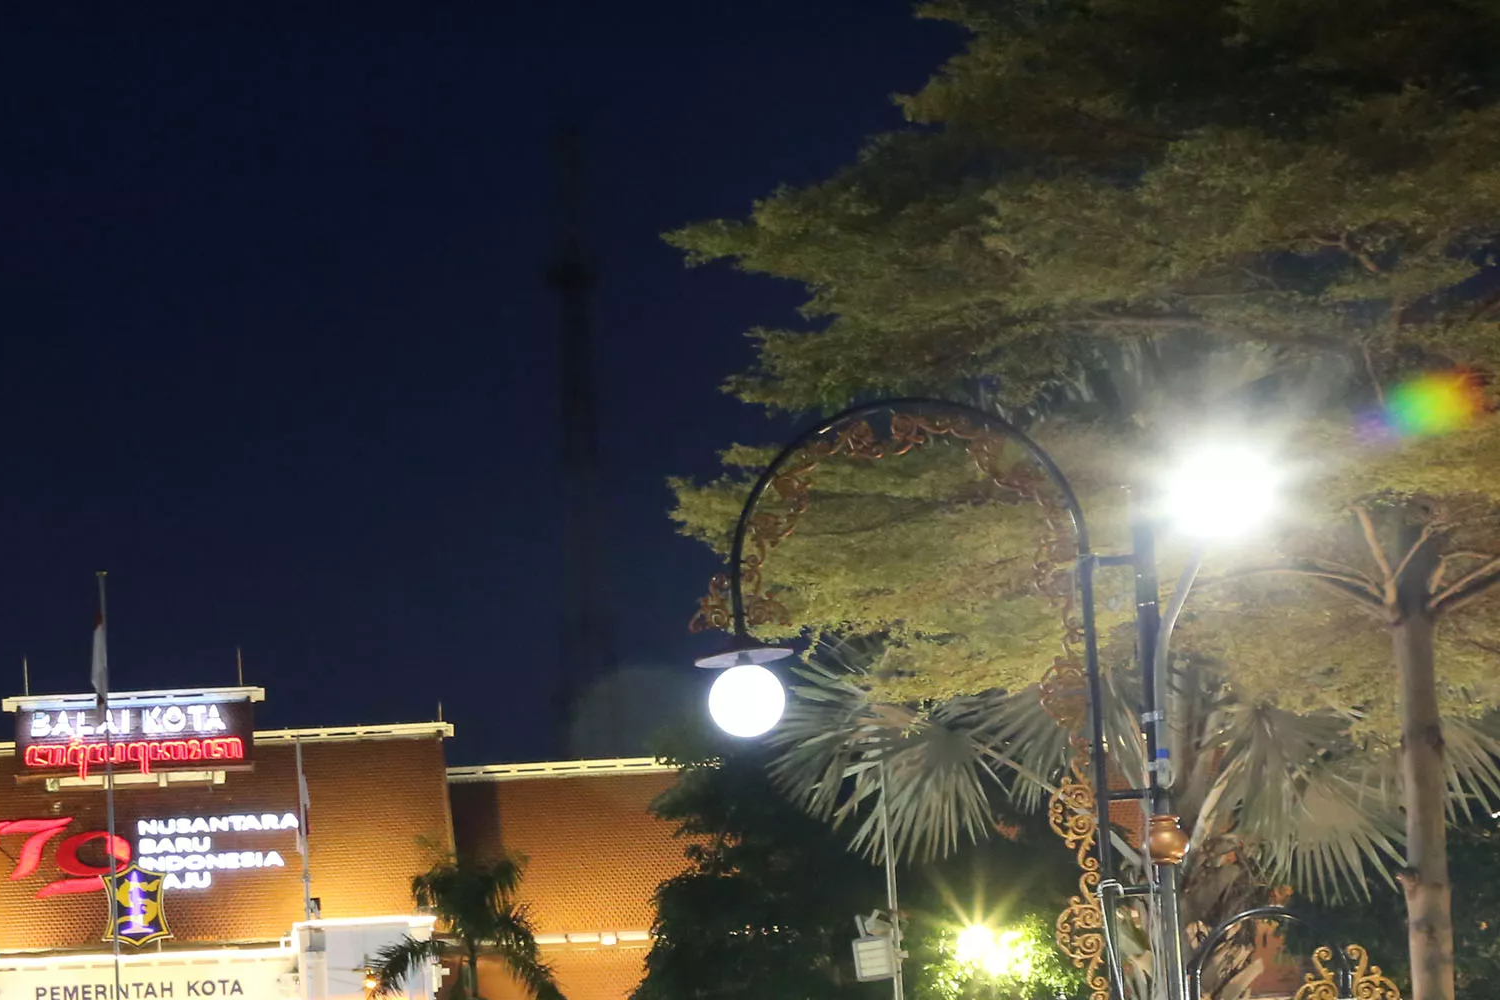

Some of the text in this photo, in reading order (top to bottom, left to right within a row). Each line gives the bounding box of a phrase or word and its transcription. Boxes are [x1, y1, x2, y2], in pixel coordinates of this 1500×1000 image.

[31, 704, 227, 737] BALAI KOTA
[137, 813, 299, 836] NUSANTARA
[138, 836, 211, 854] BARU
[138, 850, 285, 871] INDONESIA
[161, 872, 211, 890] AJU
[187, 979, 244, 997] KOTA
